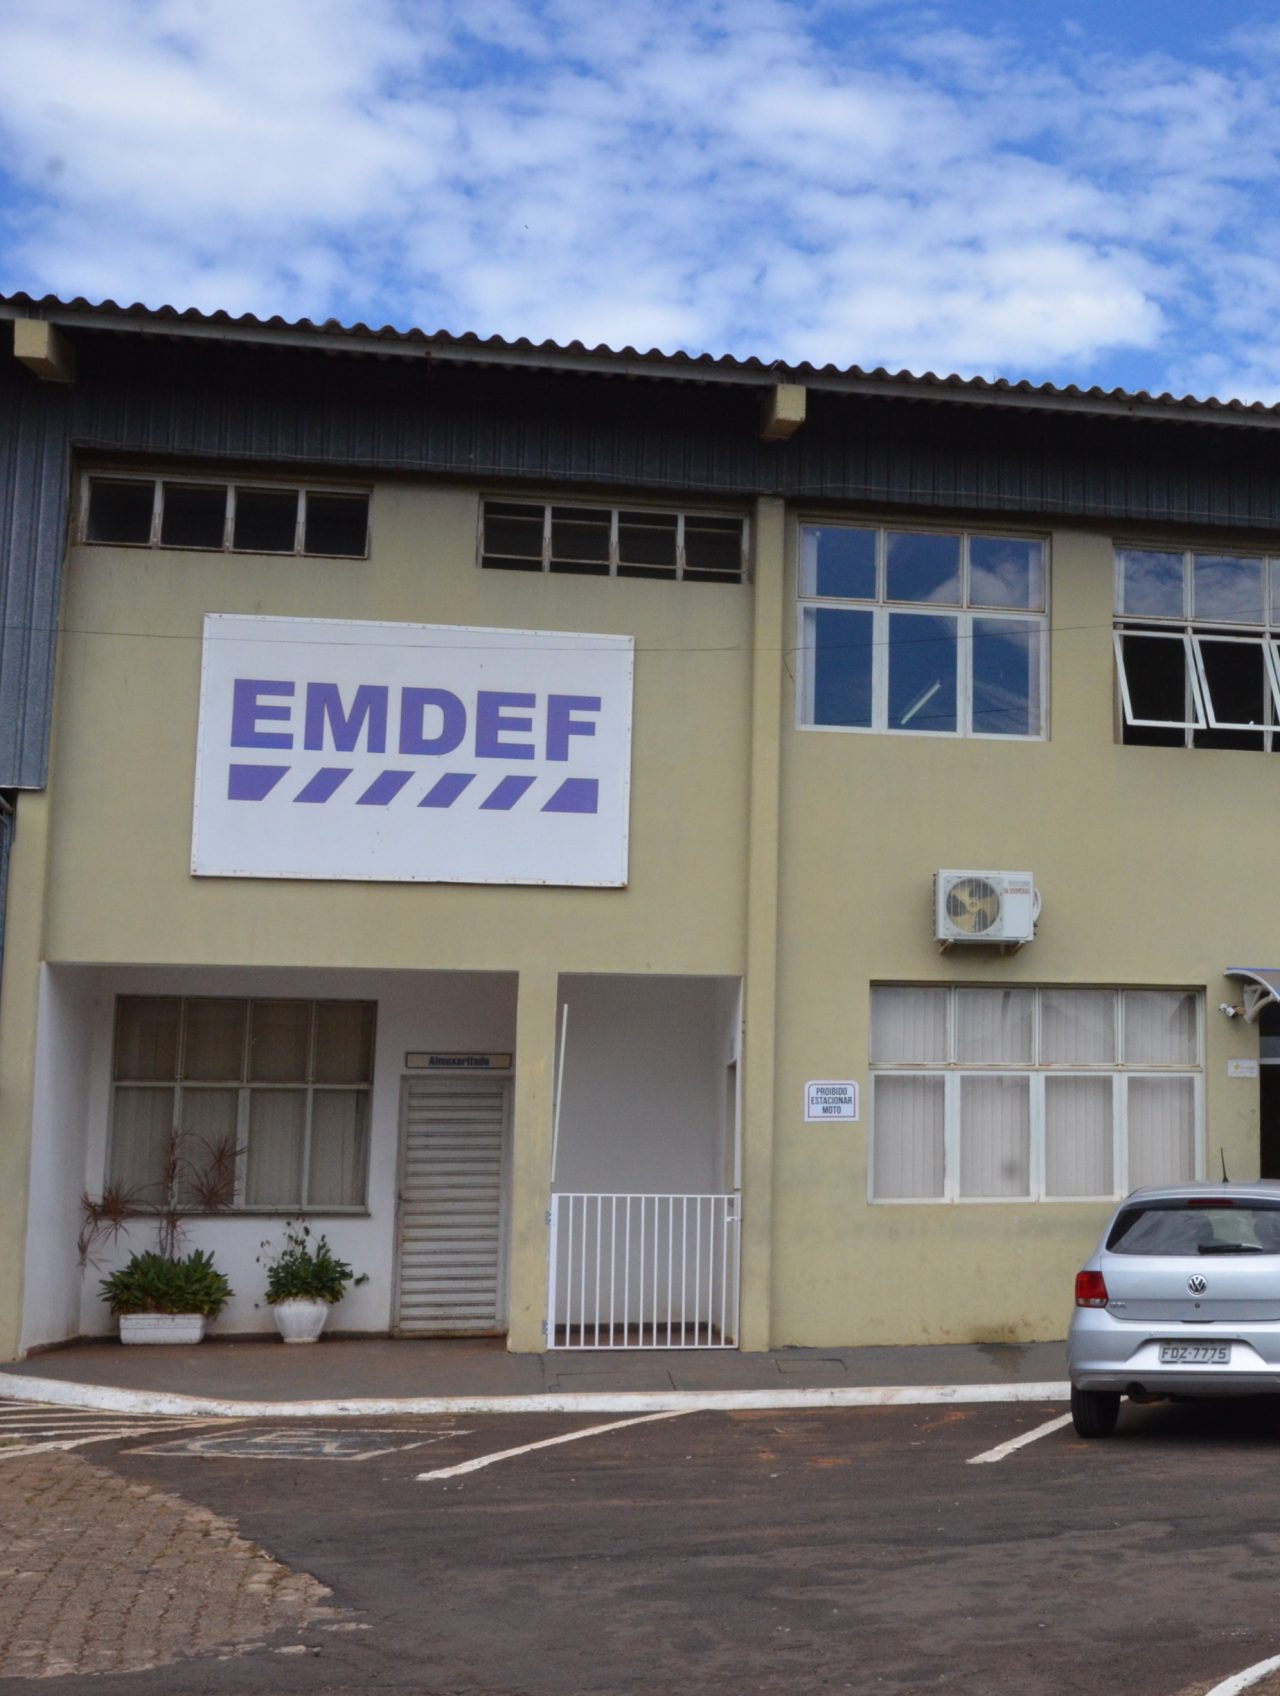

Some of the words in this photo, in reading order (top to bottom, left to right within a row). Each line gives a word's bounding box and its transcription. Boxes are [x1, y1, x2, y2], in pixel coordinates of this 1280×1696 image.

[231, 679, 601, 761] EMDEF
[428, 1055, 490, 1066] Almoxarifado
[816, 1087, 848, 1096] PROIBIDO
[811, 1096, 852, 1105] ESTACIONAR
[822, 1105, 842, 1114] MOTO
